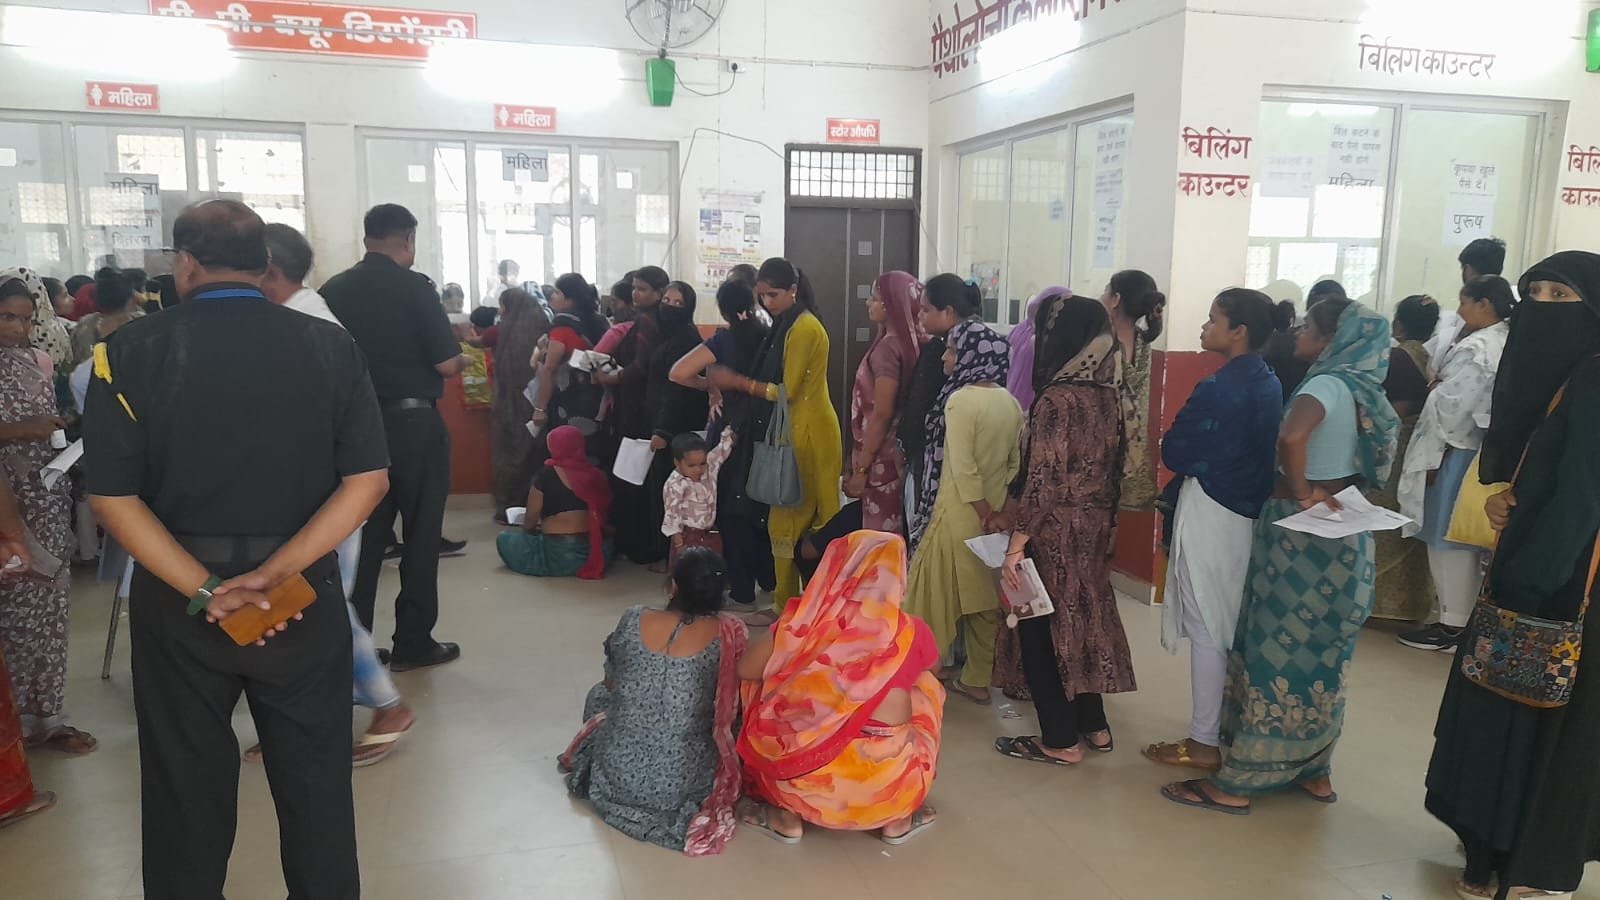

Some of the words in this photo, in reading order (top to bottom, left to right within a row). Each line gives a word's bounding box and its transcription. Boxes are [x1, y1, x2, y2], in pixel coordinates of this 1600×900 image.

[107, 87, 153, 106] महिला
[511, 108, 551, 128] महिला
[1182, 126, 1253, 160] बिलिंग
[504, 152, 548, 170] महिला
[1178, 173, 1250, 198] काउन्टर
